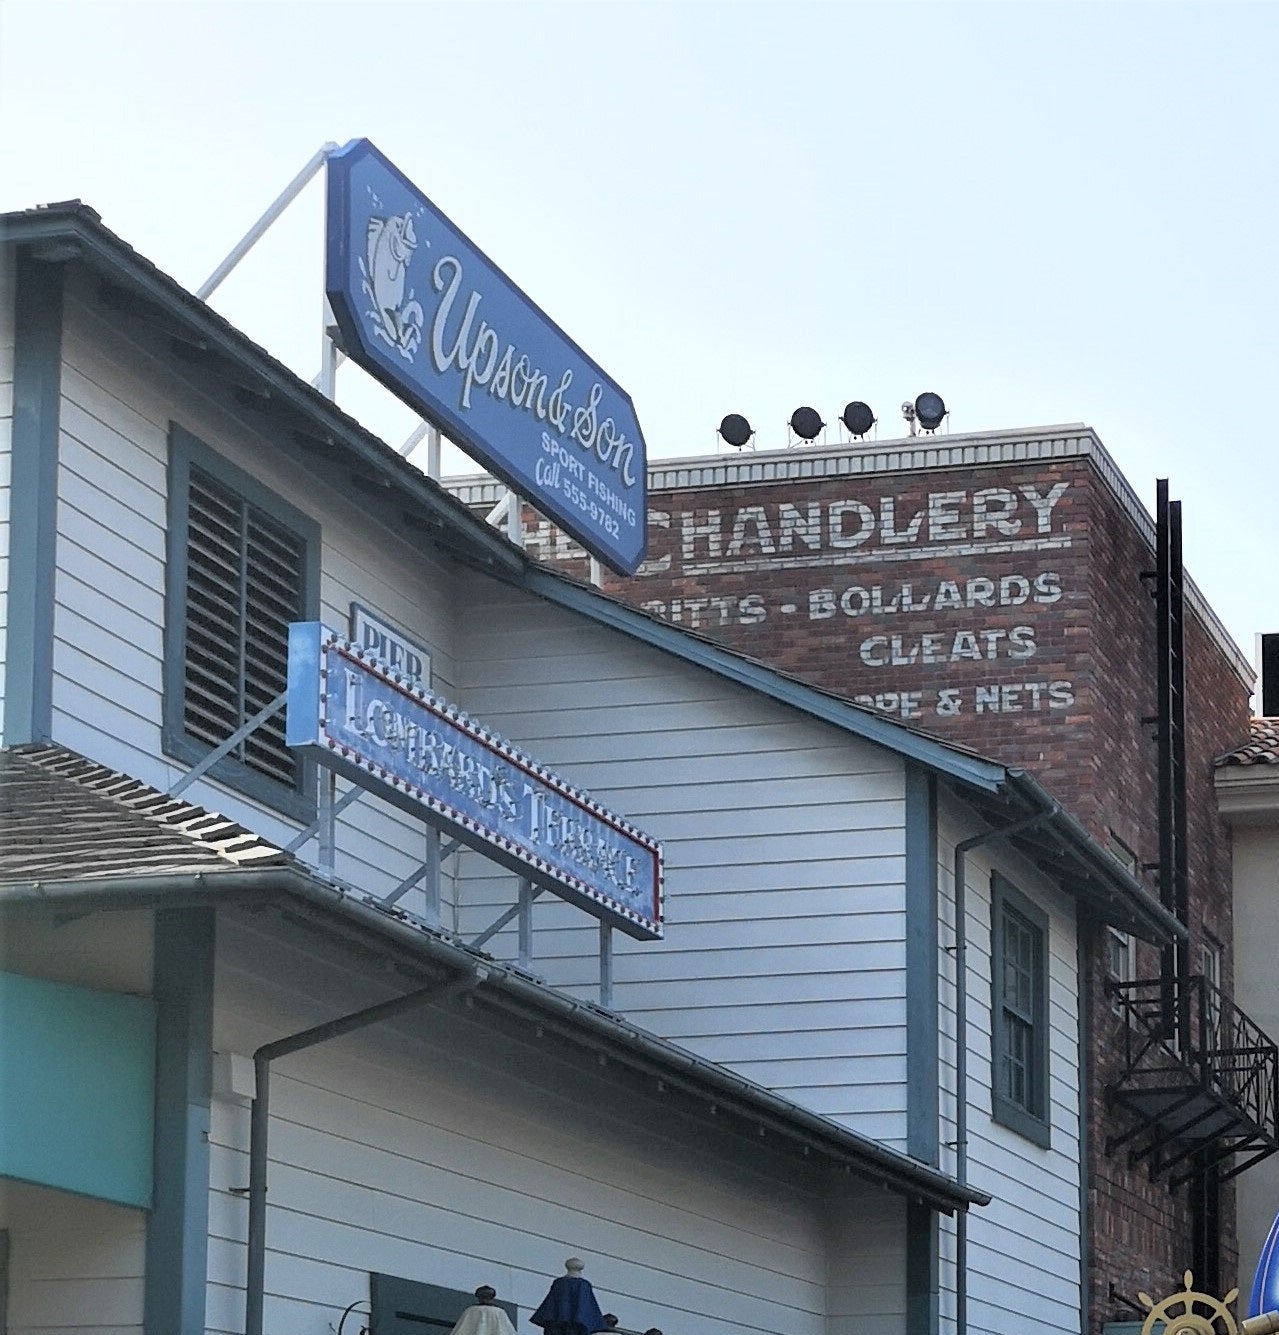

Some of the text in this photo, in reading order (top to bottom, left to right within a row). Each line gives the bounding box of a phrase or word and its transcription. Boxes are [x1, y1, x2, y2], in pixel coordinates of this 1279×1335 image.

[432, 255, 637, 487] Upson & Son
[535, 457, 620, 541] Call 555-9782
[541, 431, 637, 527] SPORT FISHING
[808, 571, 1064, 621] BOLLARDS
[859, 626, 1038, 667] CLEATS
[936, 687, 963, 717] &
[975, 681, 1075, 715] NETS
